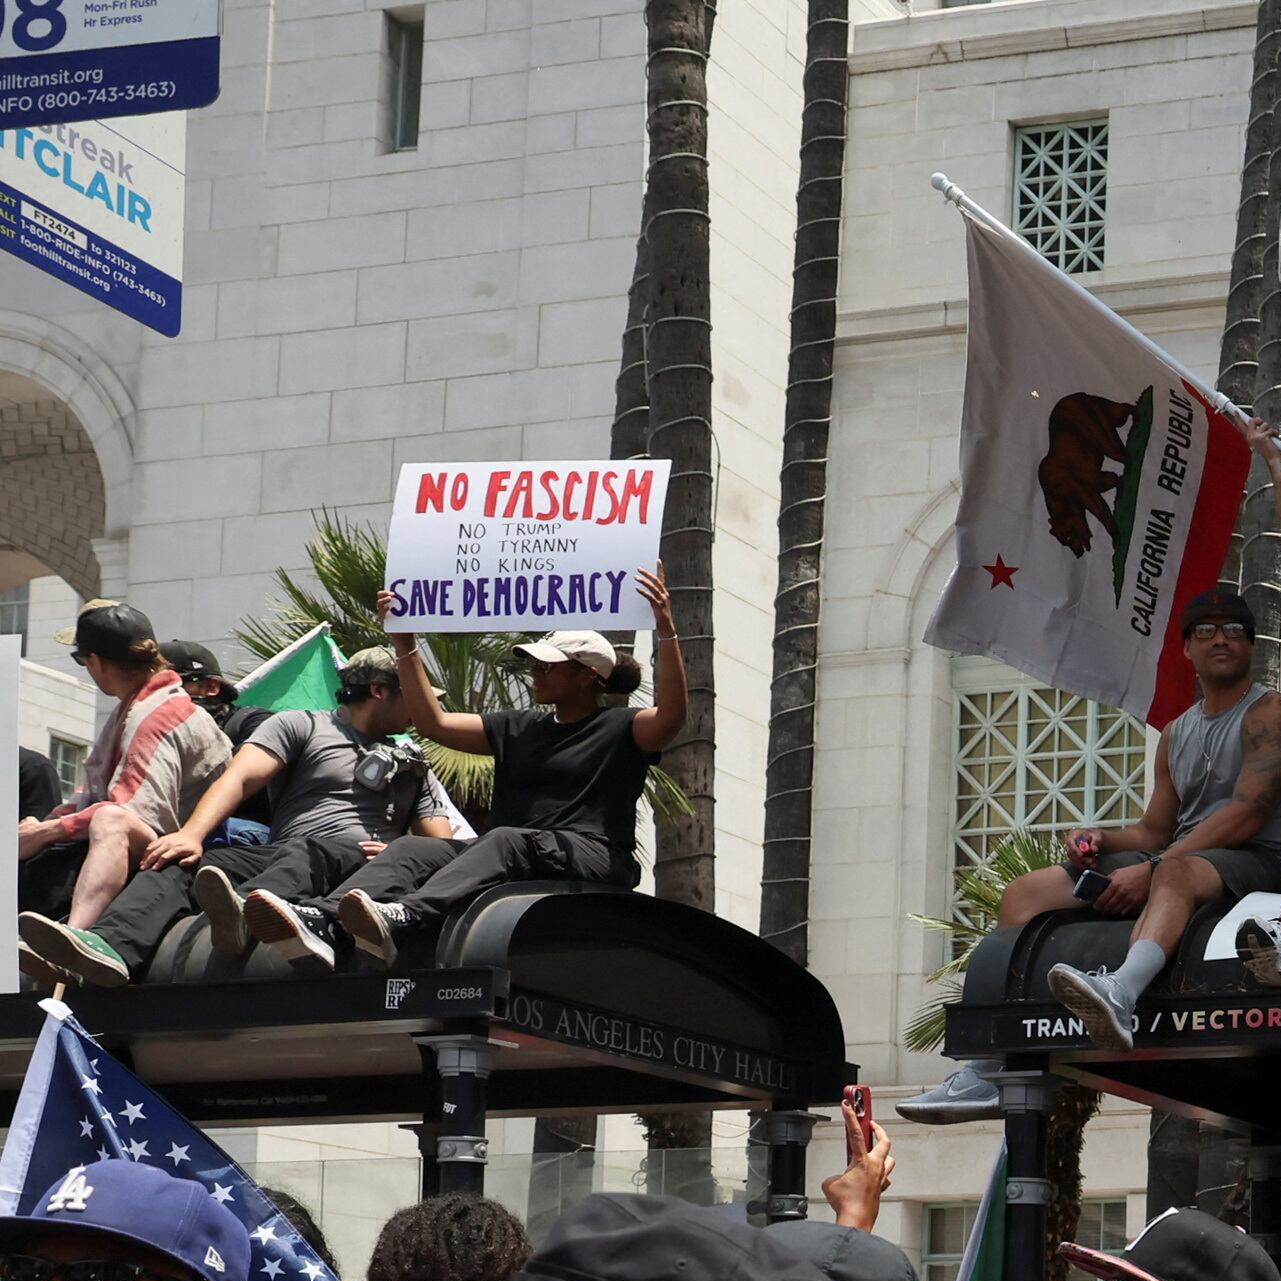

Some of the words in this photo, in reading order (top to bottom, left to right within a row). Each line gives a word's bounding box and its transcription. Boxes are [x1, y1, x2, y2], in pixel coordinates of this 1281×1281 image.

[84, 18, 97, 28] Hr
[100, 14, 143, 27] Express
[37, 81, 177, 112] (800-743-3463)
[0, 128, 153, 234] TCLAIR
[20, 219, 111, 276] 1-800-RIDE-INFO
[113, 270, 167, 307] (743-3463)
[20, 235, 111, 293] foothilltransit.org
[33, 210, 77, 241] FT2474
[91, 242, 102, 256] to
[104, 248, 138, 275] 321123
[415, 472, 469, 514] NO
[484, 469, 654, 526] FASCISM
[457, 542, 481, 556] NO
[499, 538, 579, 554] TYRANNY
[459, 523, 486, 540] NO
[502, 522, 562, 536] TRUMP
[456, 558, 481, 574] NO
[499, 557, 555, 574] KINGS
[1131, 509, 1175, 637] CALIFORNIA
[390, 578, 453, 617] SAVE
[463, 570, 627, 618] DEMOCRACY
[437, 987, 483, 1000] CD2684
[1149, 1012, 1162, 1033] /
[554, 1008, 665, 1059] ANGELES
[673, 1037, 728, 1074] CITY
[734, 1051, 791, 1091] HALL
[47, 1163, 94, 1212] LA
